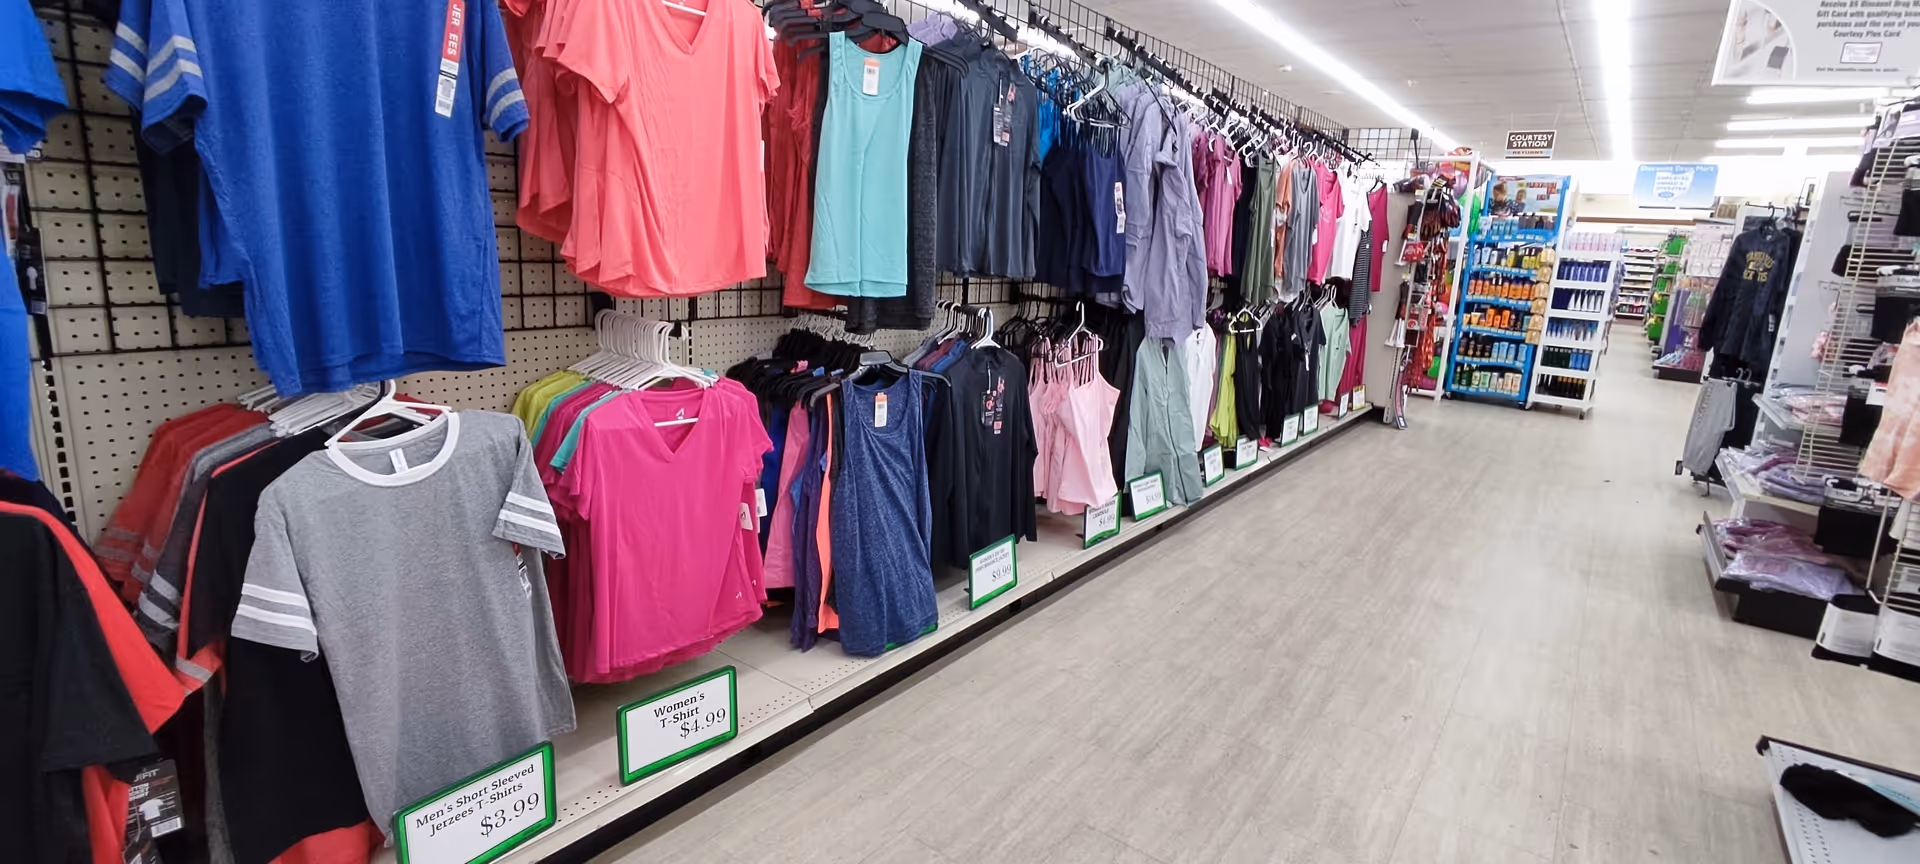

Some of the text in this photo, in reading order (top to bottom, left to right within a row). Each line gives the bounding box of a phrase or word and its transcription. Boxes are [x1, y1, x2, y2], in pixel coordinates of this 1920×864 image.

[1816, 10, 1830, 18] Gift
[1831, 10, 1847, 18] Card
[1849, 10, 1865, 18] with
[1866, 11, 1902, 19] qualifying
[1860, 0, 1891, 8] Discount
[1893, 0, 1910, 8] Drug
[1816, 20, 1852, 29] purchases
[1854, 20, 1867, 28] and
[1869, 20, 1881, 28] the
[1833, 30, 1864, 38] Courtesy
[1883, 30, 1901, 38] Card
[992, 564, 1012, 582] $9.99
[654, 691, 705, 718] Women's
[660, 707, 700, 729] T-Shirt
[680, 708, 726, 739] $4.99
[415, 764, 535, 828] Men's Short Sleeved
[430, 783, 523, 837] Jerzees T-Shirts
[480, 792, 540, 837] $3.99
